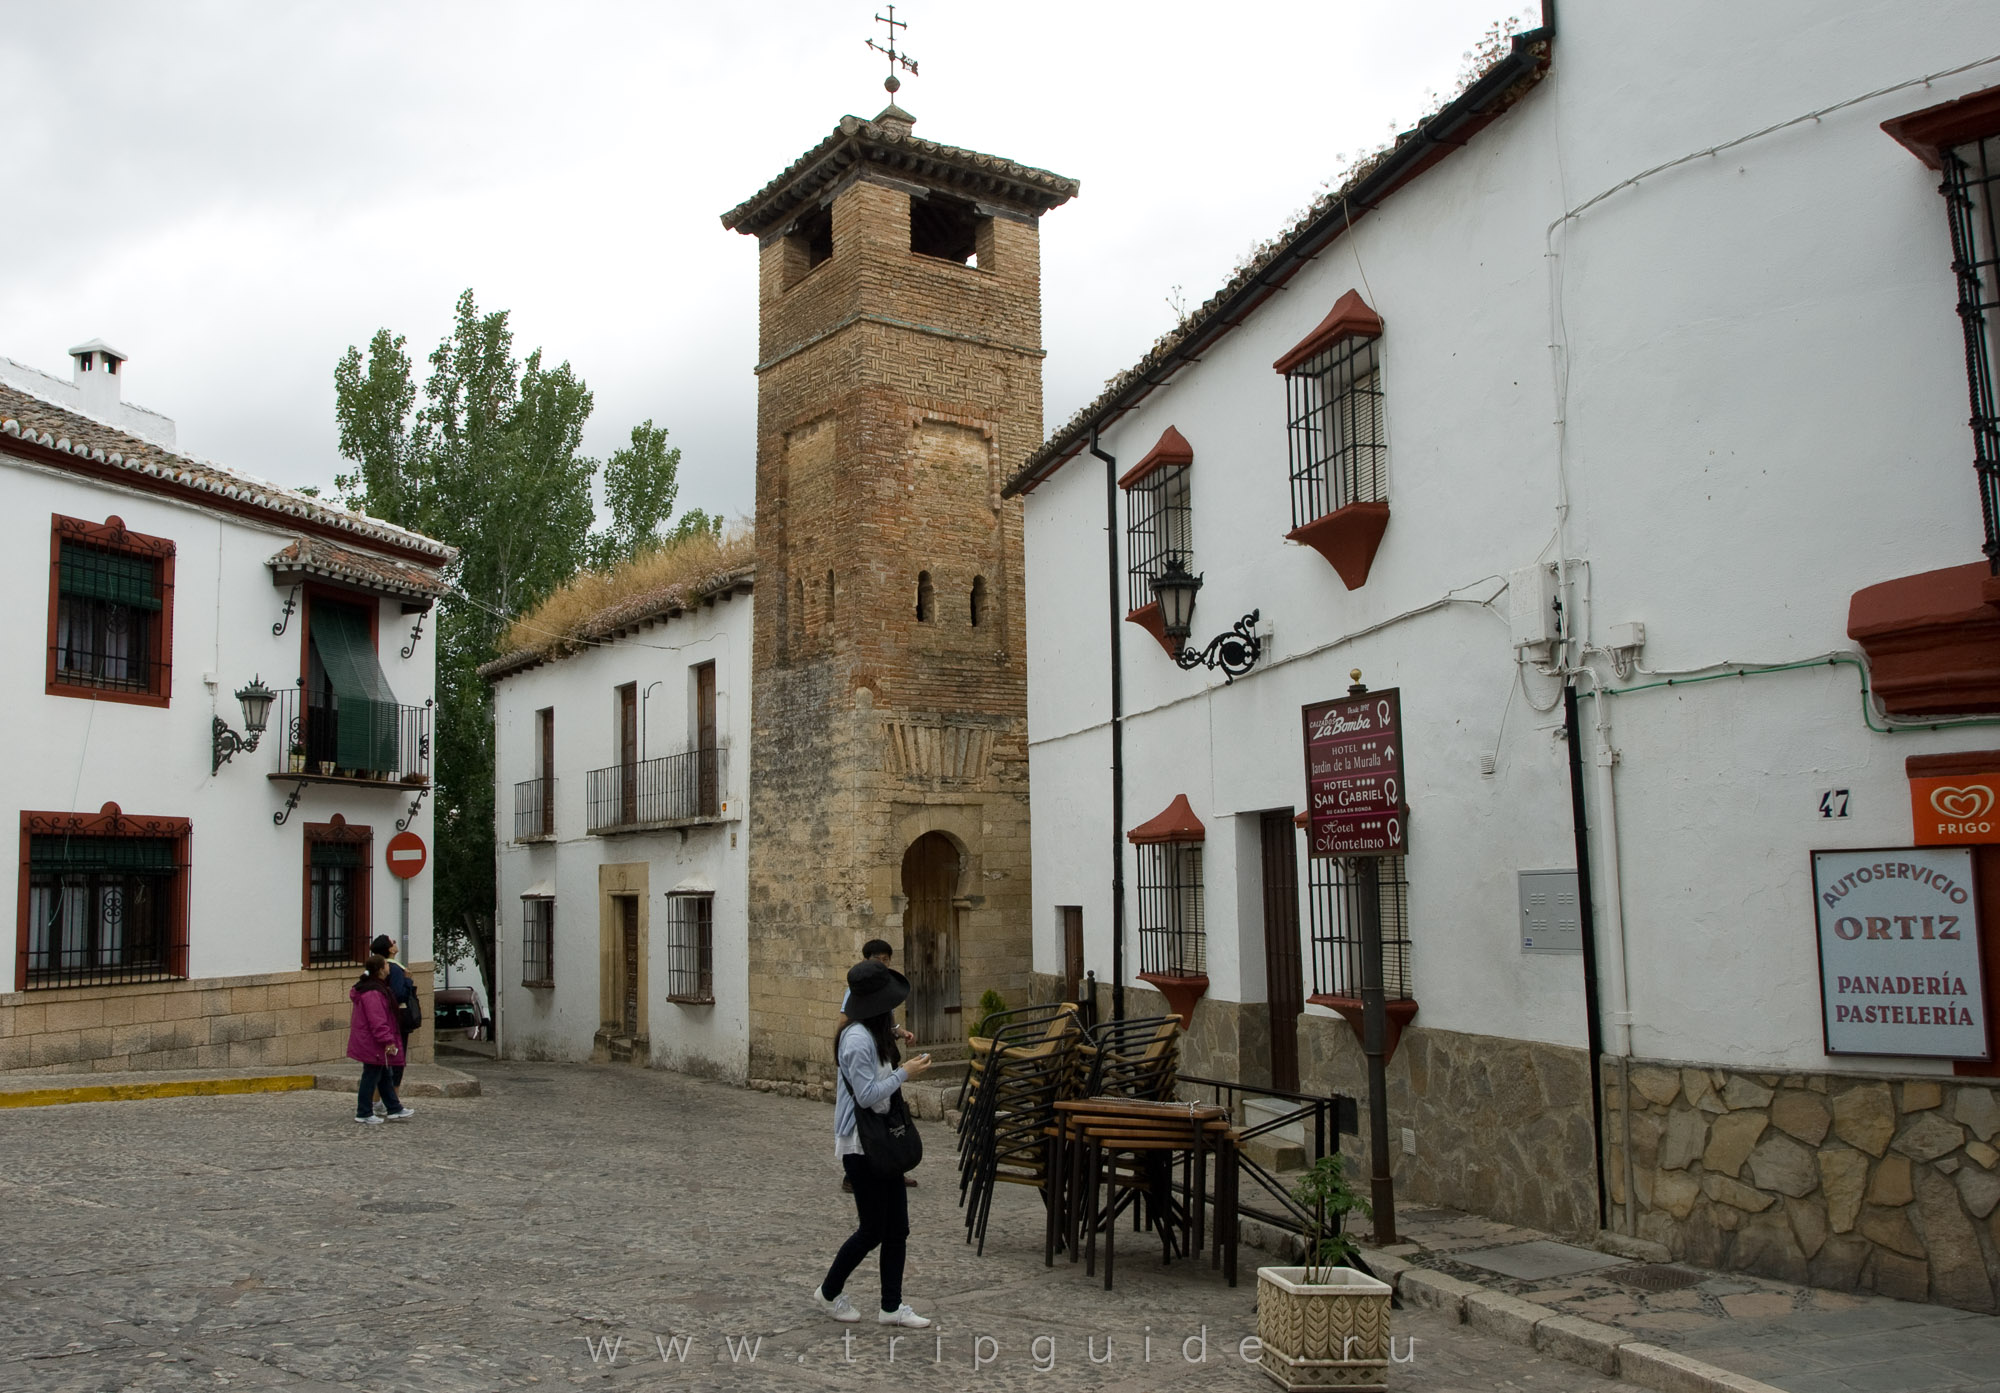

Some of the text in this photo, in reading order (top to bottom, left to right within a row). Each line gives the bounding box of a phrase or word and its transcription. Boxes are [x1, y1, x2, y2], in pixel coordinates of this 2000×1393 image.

[1309, 718, 1337, 729] CALZADOS
[1332, 714, 1371, 736] Bomba
[1332, 744, 1358, 756] HOTEL
[1333, 759, 1343, 772] de
[1344, 757, 1352, 770] la
[1353, 753, 1381, 769] Muralla
[1323, 780, 1354, 791] HOTEL
[1819, 789, 1849, 818] 47
[1321, 820, 1354, 834] Hotel
[1937, 822, 1991, 835] FRIGO
[1822, 862, 1968, 909] AUTOSERVICIO
[1834, 915, 1961, 941] ORTIZ
[1837, 971, 1968, 996] PANADERÍA
[1836, 1001, 1974, 1026] PASTELERÍA
